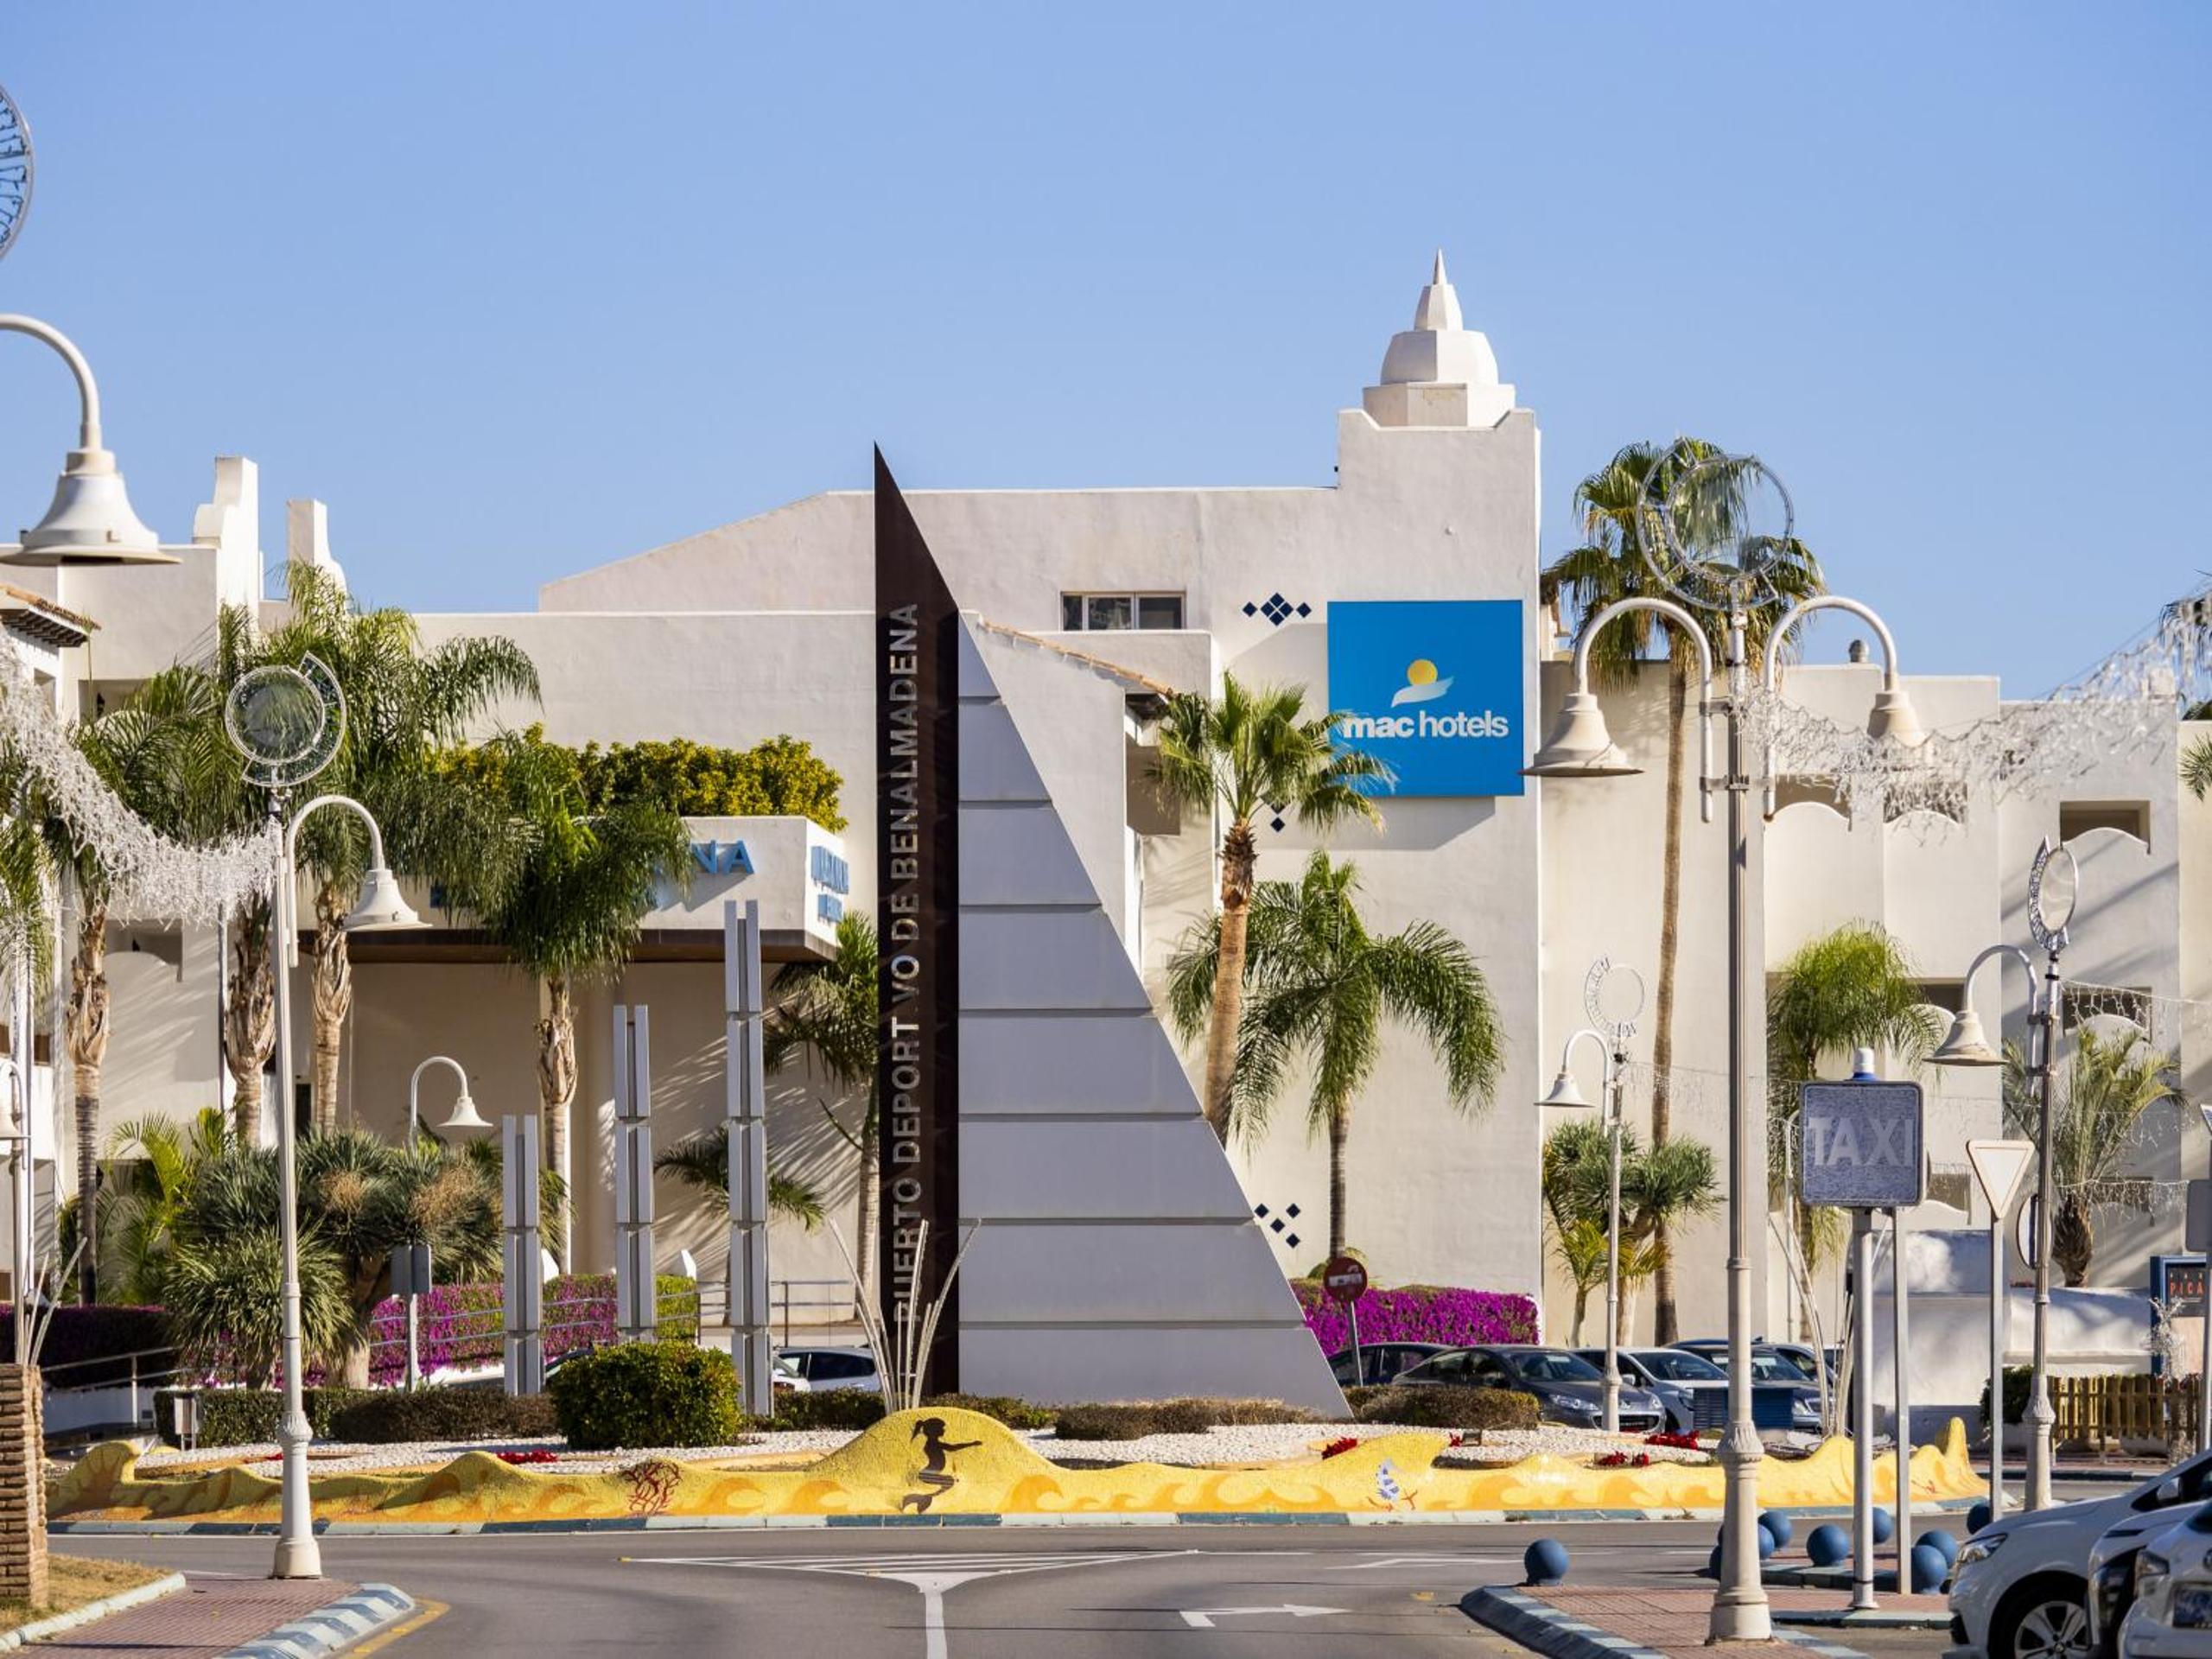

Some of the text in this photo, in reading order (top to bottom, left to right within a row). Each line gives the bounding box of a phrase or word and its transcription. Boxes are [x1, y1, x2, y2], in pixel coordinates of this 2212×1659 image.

[889, 604, 918, 879] BENALMADENA
[1343, 709, 1510, 739] mac hotels
[891, 893, 919, 940] DE
[1808, 1116, 1915, 1166] TAXI
